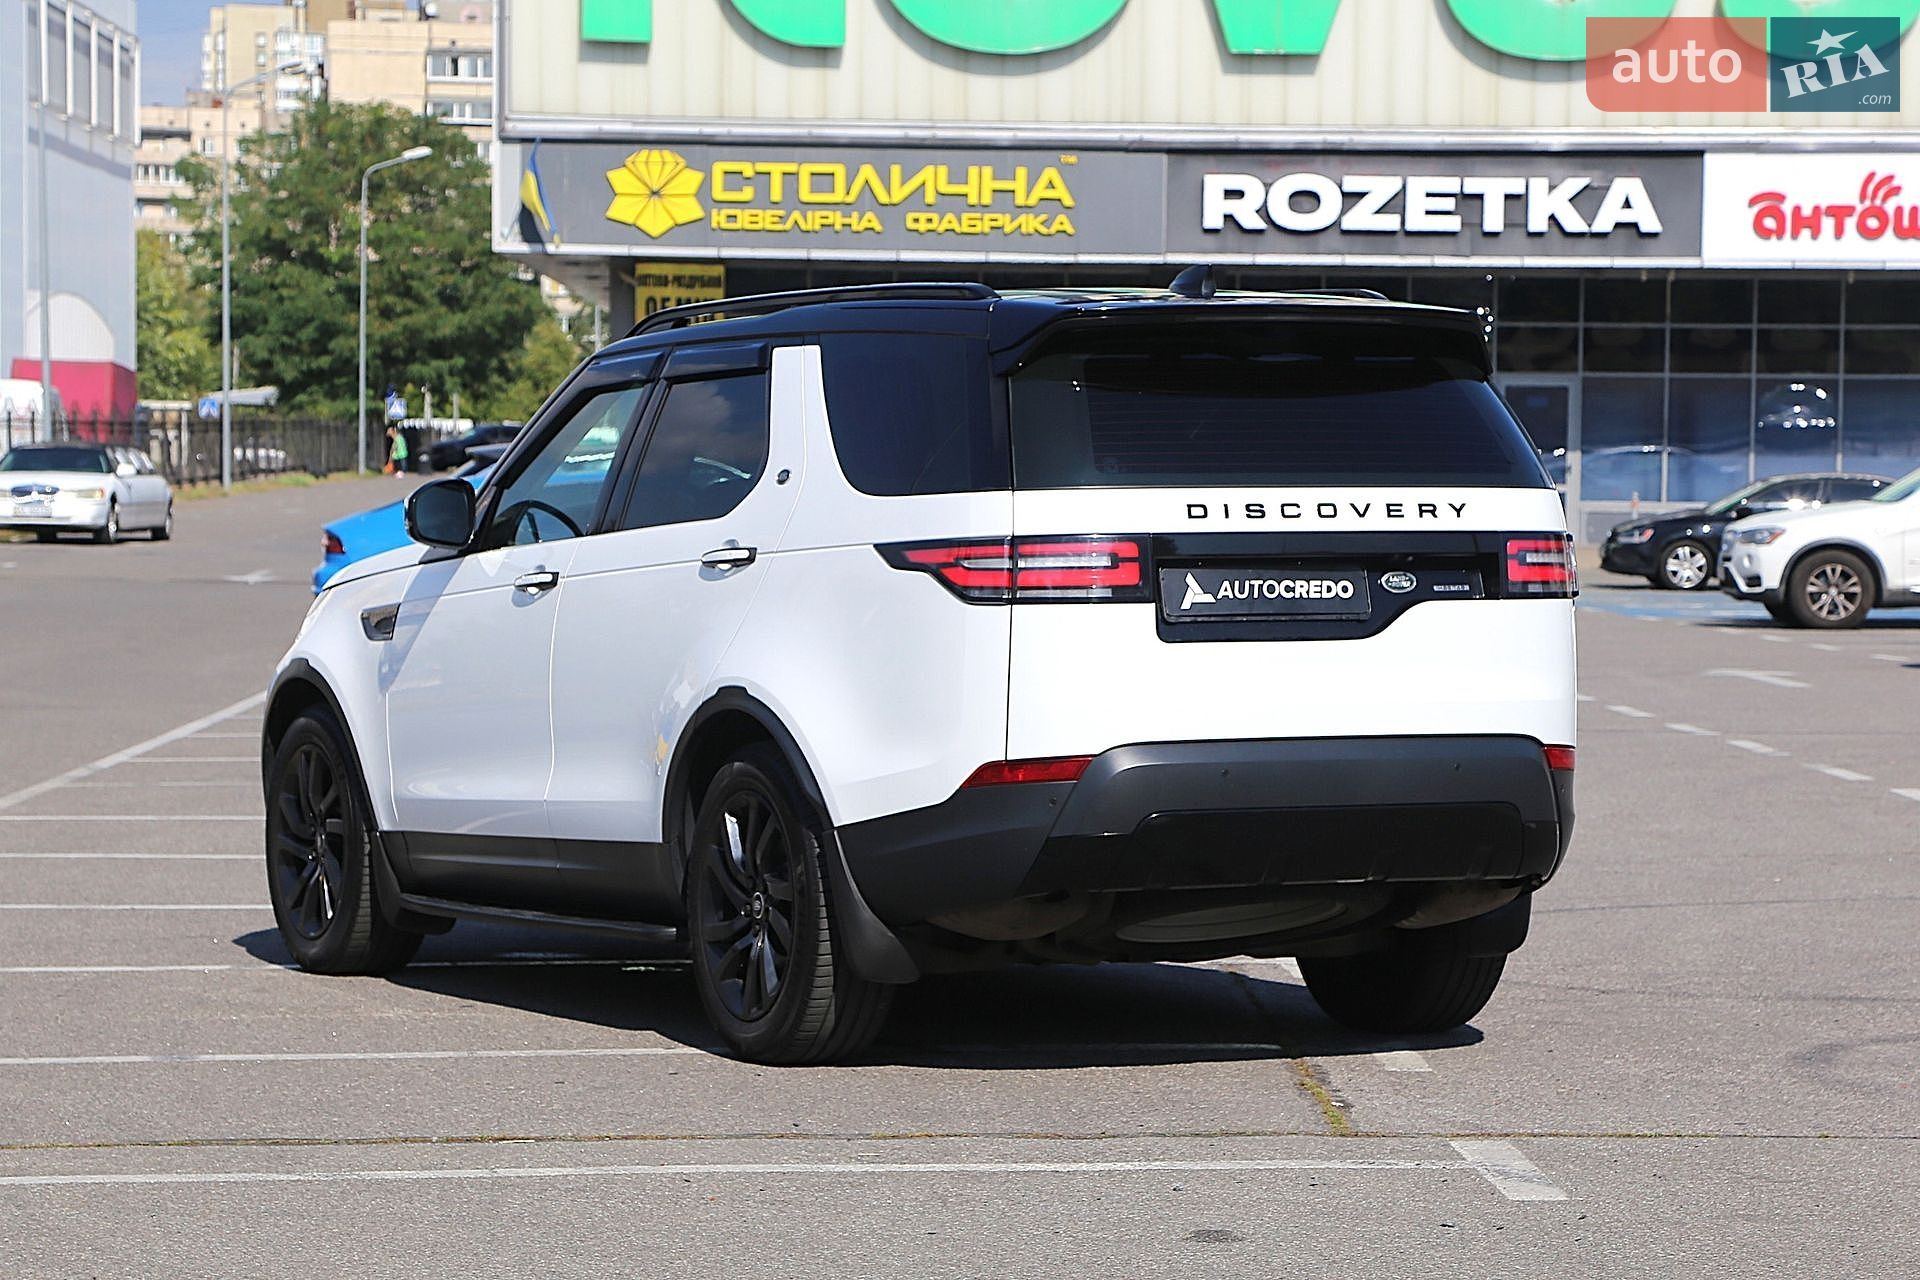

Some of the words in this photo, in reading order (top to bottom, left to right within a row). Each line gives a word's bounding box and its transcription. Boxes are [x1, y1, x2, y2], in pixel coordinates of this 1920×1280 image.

[711, 161, 1075, 207] СТОЛИЧНА
[1201, 173, 1662, 234] ROZETKA
[711, 209, 883, 233] ЮВЕЛІРНА
[905, 209, 1075, 235] ФАБРИКА
[1187, 502, 1466, 519] DISCOVERY
[1216, 580, 1354, 600] AUTOCREDO
